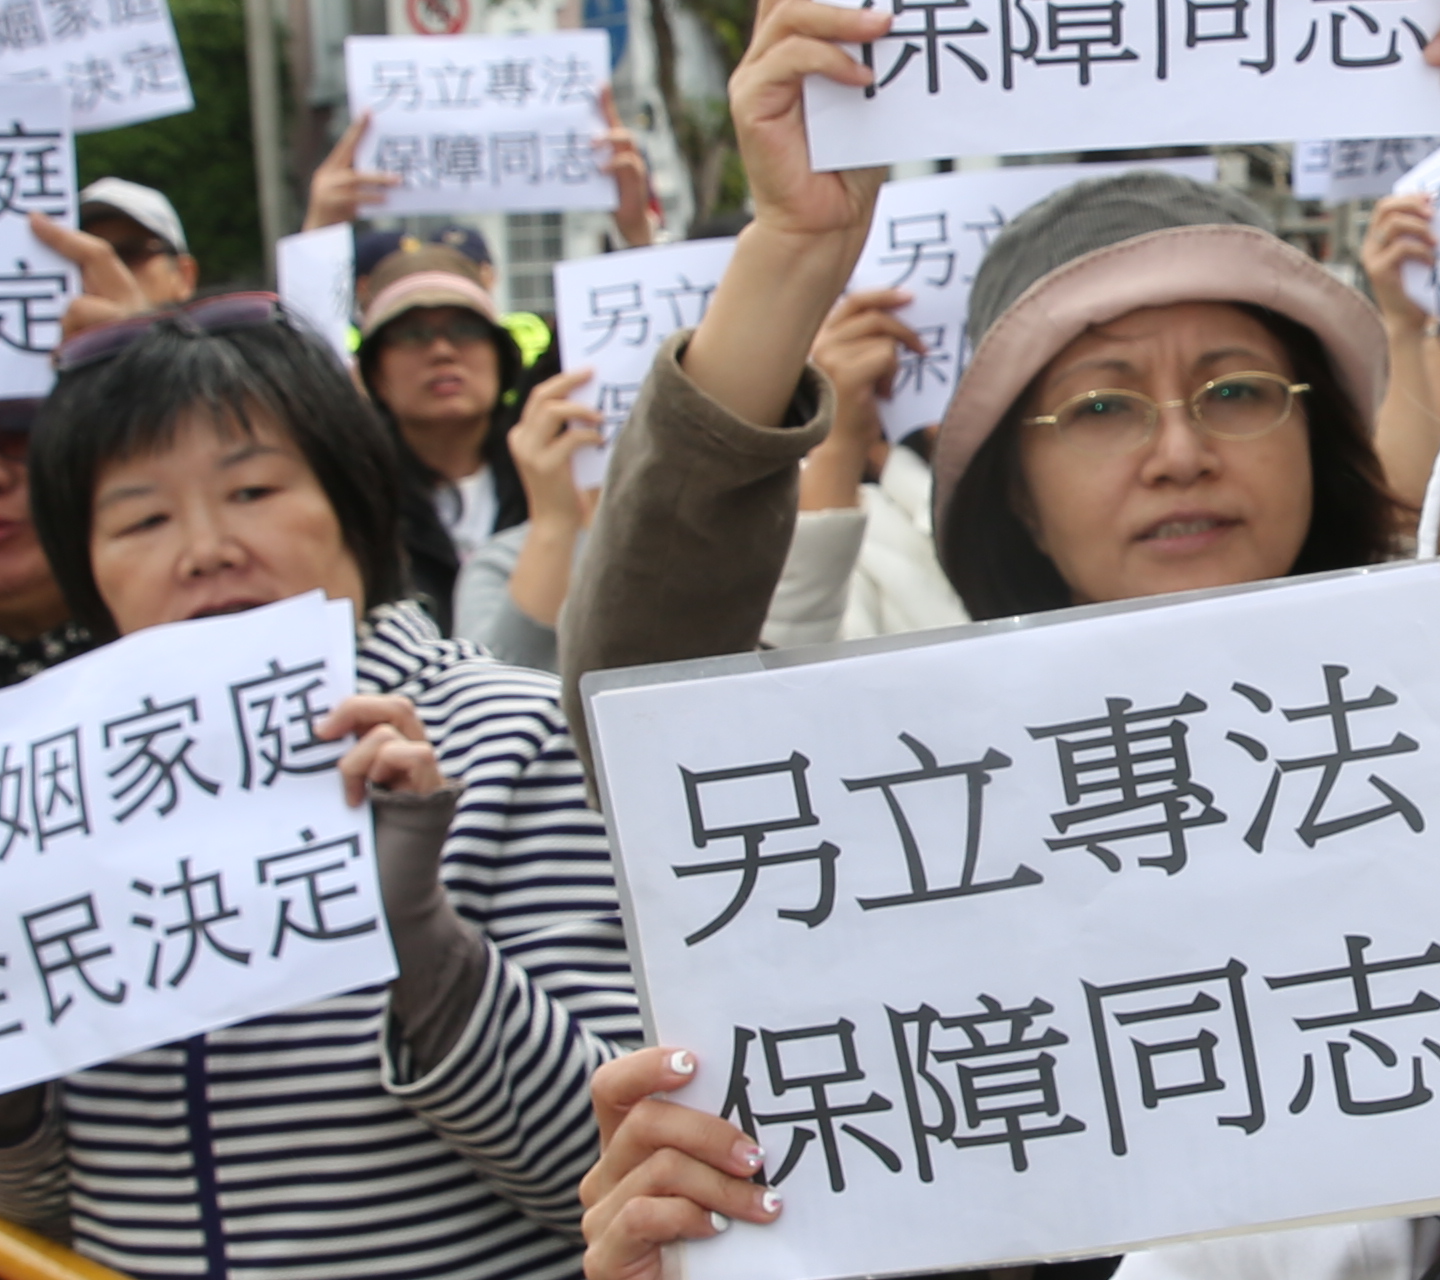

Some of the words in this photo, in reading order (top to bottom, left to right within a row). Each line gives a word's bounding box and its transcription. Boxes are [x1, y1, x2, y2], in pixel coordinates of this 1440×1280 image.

[371, 54, 597, 111] 另立專法
[374, 130, 594, 191] 保障同志
[672, 665, 1424, 946] 另立專法
